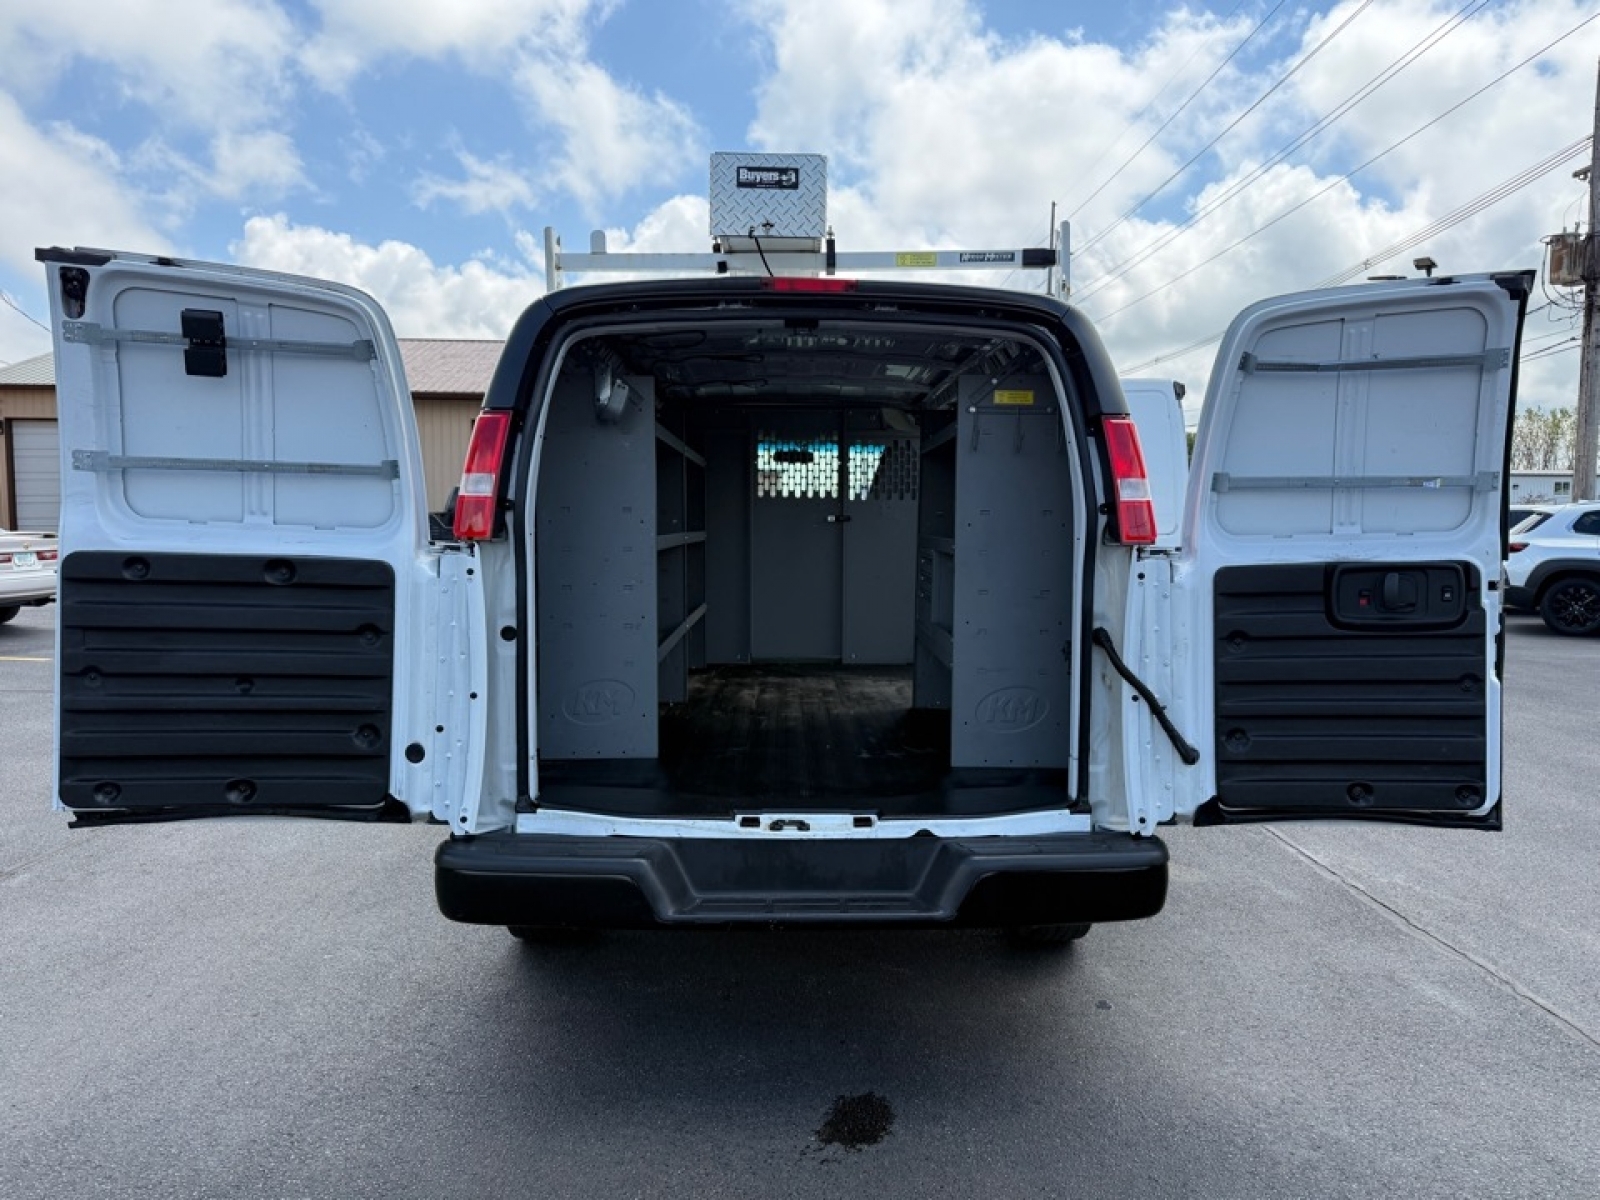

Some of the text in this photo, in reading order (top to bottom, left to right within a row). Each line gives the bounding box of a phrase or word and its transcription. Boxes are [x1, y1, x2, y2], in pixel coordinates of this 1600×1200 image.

[739, 168, 779, 182] Buyers
[571, 688, 623, 716] KM
[985, 694, 1038, 723] KM
